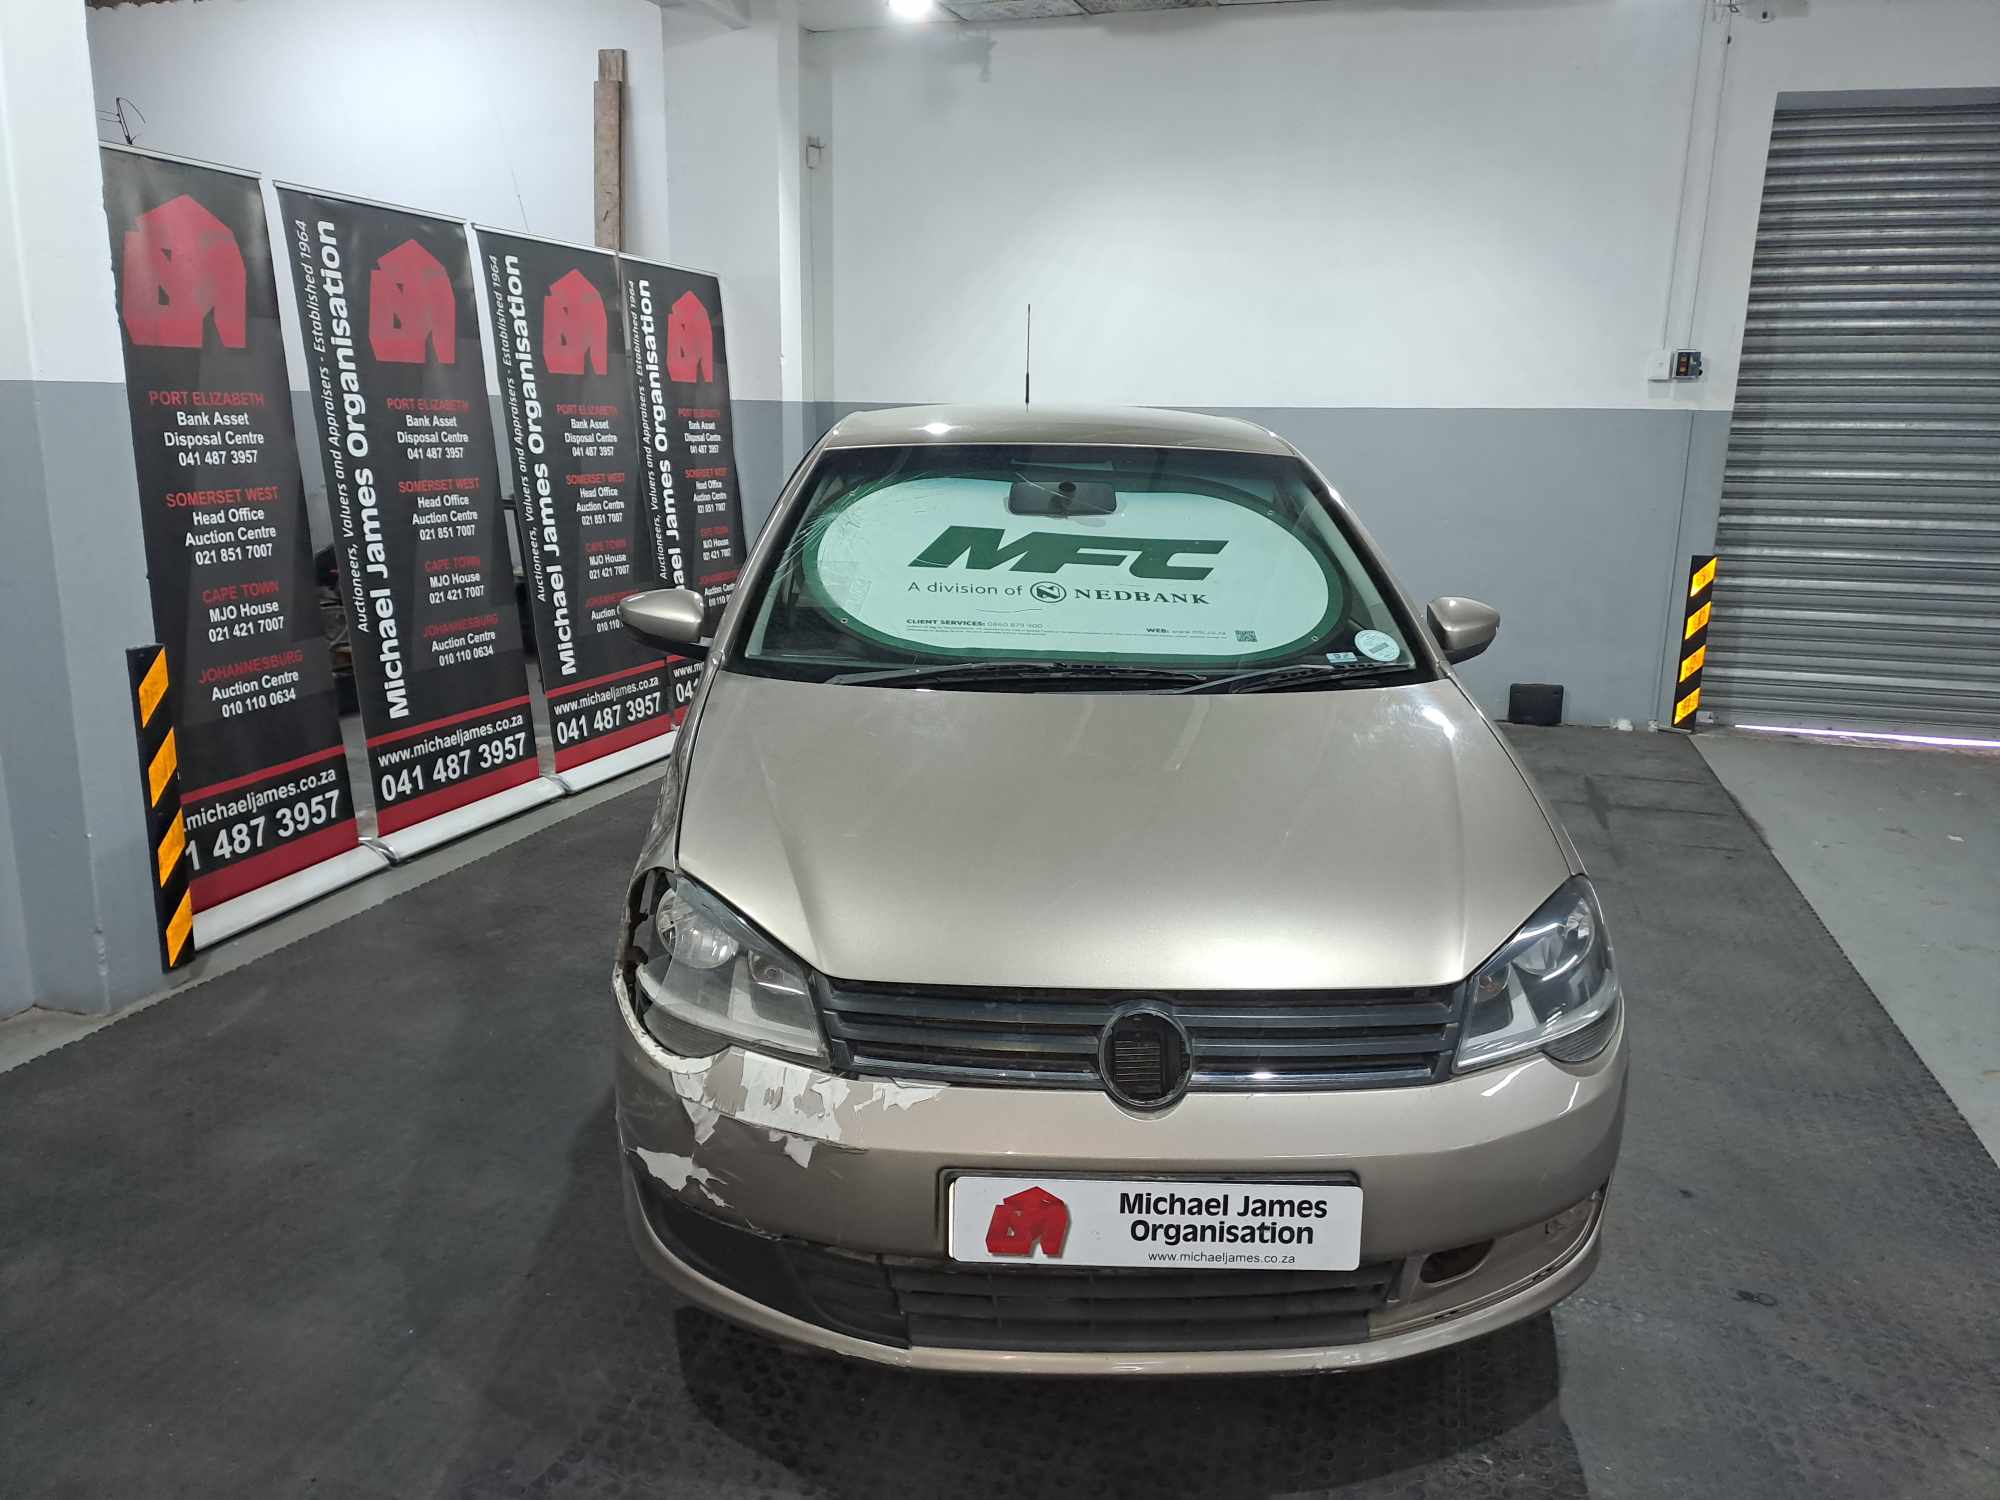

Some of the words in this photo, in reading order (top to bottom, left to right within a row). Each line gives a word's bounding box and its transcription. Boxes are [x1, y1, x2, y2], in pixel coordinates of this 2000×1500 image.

[295, 219, 311, 260] 1964
[488, 255, 502, 291] 1964
[301, 263, 326, 354] Established
[317, 220, 369, 458] Organisation
[496, 292, 512, 367] Established
[630, 309, 643, 376] Established
[504, 254, 545, 456] Organisation
[639, 279, 669, 453] Organisation
[150, 392, 188, 406] PORT
[193, 392, 265, 407] ELIZABETH
[320, 368, 341, 447] Appraisers
[387, 398, 413, 412] PORT
[506, 377, 525, 446] Appraisers
[177, 412, 210, 426] Bank
[214, 412, 249, 425] Asset
[406, 415, 430, 427] Bank
[433, 415, 457, 428] Asset
[571, 418, 588, 430] Bank
[590, 418, 609, 430] Asset
[638, 384, 652, 445] Appraisers
[164, 431, 222, 449] Disposal
[225, 431, 264, 445] Centre
[397, 431, 439, 446] Disposal
[441, 431, 468, 443] Centre
[564, 433, 594, 445] Disposal
[596, 432, 618, 443] Centre
[179, 452, 201, 466] 041
[204, 451, 226, 464] 487
[231, 450, 258, 464] 3957
[332, 449, 345, 480] and
[407, 447, 423, 460] 041
[426, 448, 443, 459] 487
[446, 447, 464, 459] 3957
[516, 448, 528, 473] and
[645, 446, 654, 468] and
[166, 489, 240, 508] SOMERSET
[245, 486, 280, 500] WEST
[398, 479, 452, 493] SOMERSET
[456, 477, 480, 490] WEST
[580, 487, 597, 499] Head
[598, 486, 618, 497] Office
[648, 469, 658, 510] Valuers
[337, 483, 354, 538] Valuers
[418, 496, 441, 508] Head
[443, 495, 469, 506] Office
[520, 476, 534, 522] Valuers
[534, 462, 560, 557] James
[576, 502, 603, 513] Auction
[604, 500, 625, 511] Centre
[659, 459, 680, 541] James
[193, 509, 224, 526] Head
[228, 508, 264, 521] Office
[354, 467, 388, 579] James
[412, 512, 448, 526] Auction
[450, 510, 478, 522] Centre
[185, 531, 234, 547] Auction
[238, 526, 276, 541] Centre
[419, 528, 435, 540] 021
[437, 526, 454, 539] 851
[456, 524, 476, 537] 7007
[196, 551, 216, 566] 021
[221, 548, 242, 562] 851
[246, 544, 273, 560] 7007
[605, 553, 627, 564] House
[653, 514, 668, 580] Auctioneers,
[907, 525, 1229, 581] MFC
[424, 558, 450, 572] CAPE
[453, 556, 481, 569] TOWN
[529, 526, 546, 602] Auctioneers,
[589, 569, 600, 581] 021
[601, 567, 613, 578] 421
[203, 586, 238, 604] CAPE
[241, 581, 280, 599] TOWN
[347, 542, 369, 633] Auctioneers,
[429, 574, 450, 588] MJO
[452, 572, 481, 585] House
[907, 582, 921, 594] A
[927, 581, 998, 596] division
[1004, 584, 1023, 596] of
[1074, 588, 1211, 605] NEDBANK
[429, 592, 445, 605] 021
[447, 589, 462, 602] 421
[465, 585, 485, 599] 7007
[209, 605, 236, 623] MJO
[240, 601, 279, 618] House
[546, 565, 577, 676] Michael
[591, 607, 616, 621] Auction
[940, 619, 986, 627] SERVICES:
[208, 628, 229, 643] 021
[233, 622, 254, 639] 421
[258, 616, 284, 634] 7007
[609, 620, 621, 631] 110
[369, 589, 410, 719] Michael
[431, 636, 466, 652] Auction
[467, 630, 496, 645] Centre
[199, 649, 304, 684] JOHANNESBURG
[439, 653, 455, 667] 010
[456, 649, 471, 662] 110
[473, 644, 494, 659] 0634
[212, 681, 258, 702] Auction
[262, 670, 299, 689] Centre
[554, 675, 659, 716] www.michaeljames.co.za
[222, 702, 242, 718] 010
[246, 696, 266, 713] 110
[270, 687, 296, 707] 0634
[556, 715, 588, 745] 041
[593, 705, 621, 732] 487
[625, 691, 661, 722] 3957
[377, 713, 524, 768] www.michaeljames.co.za
[381, 766, 424, 801] 041
[433, 750, 471, 784] 487
[479, 732, 526, 769] 3957
[184, 768, 337, 833] .michaeljames.co.za
[213, 817, 266, 861] 487
[276, 790, 341, 838] 3957
[1118, 1192, 1230, 1217] Michael
[1237, 1194, 1329, 1219] James
[1130, 1218, 1314, 1247] Organisation
[1147, 1249, 1296, 1265] www.michaeljames.co.za
